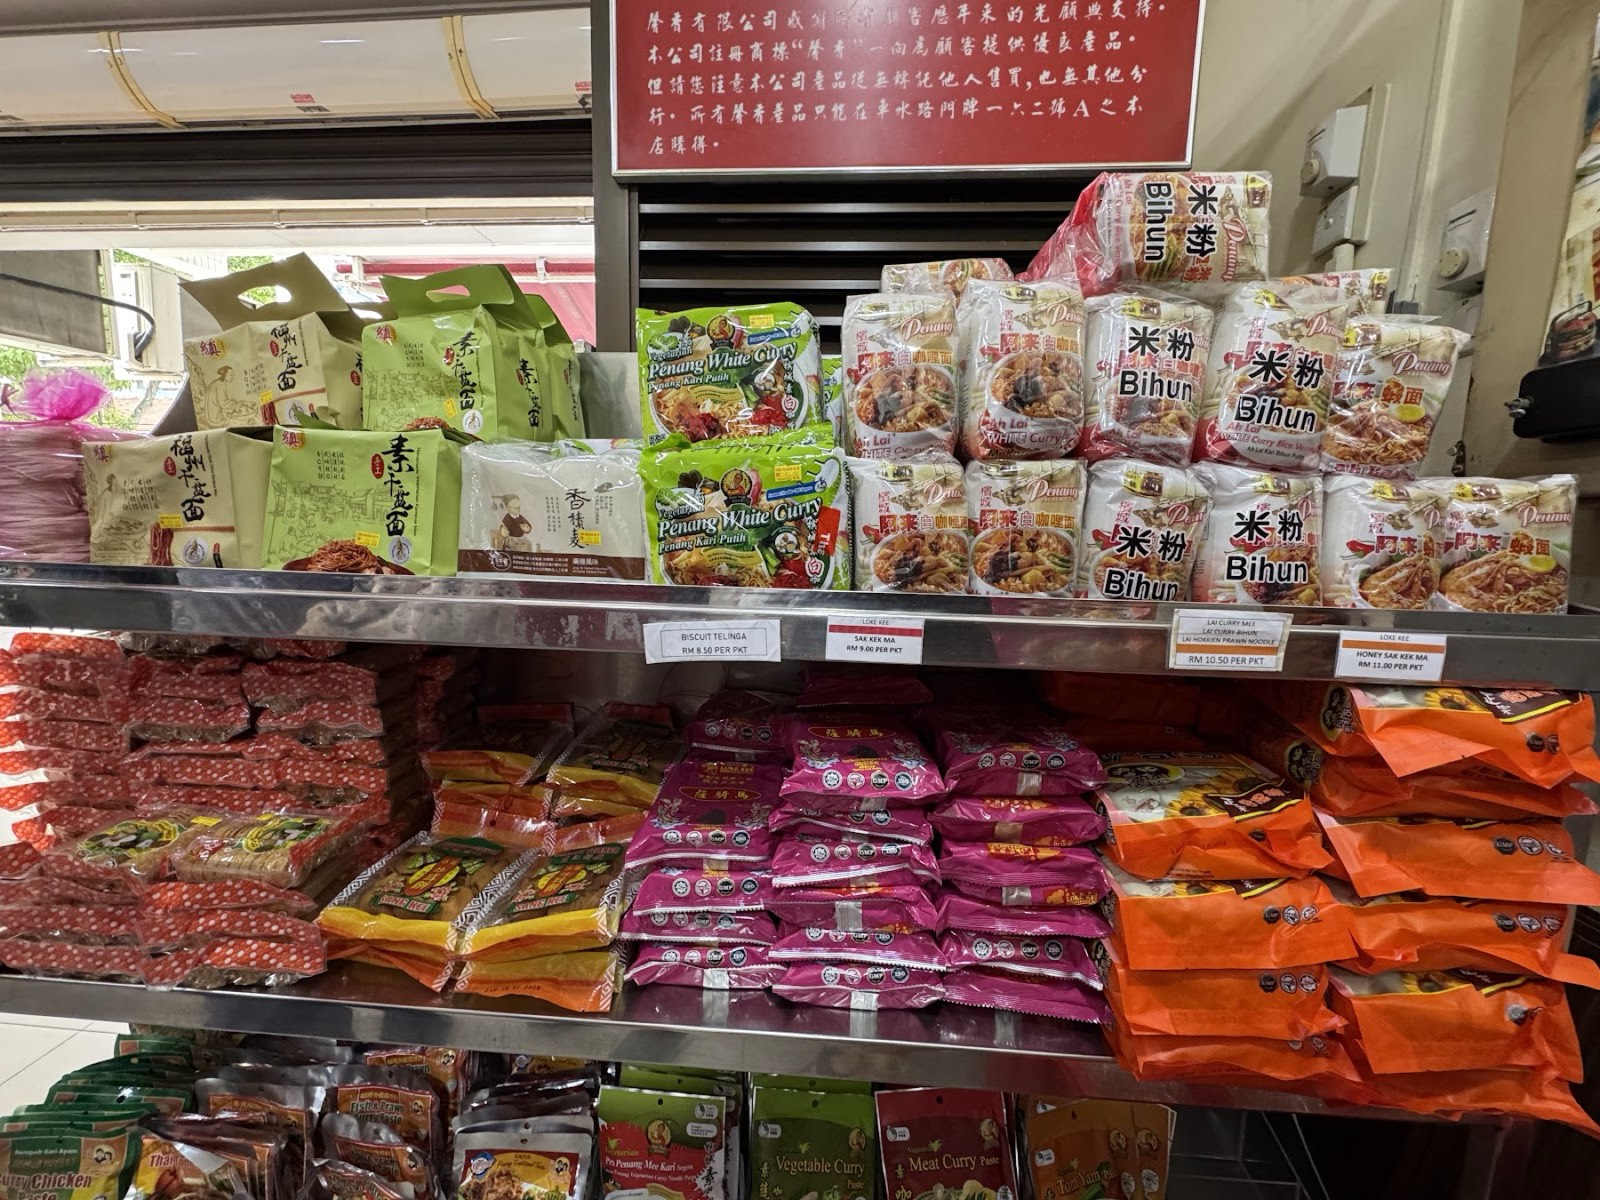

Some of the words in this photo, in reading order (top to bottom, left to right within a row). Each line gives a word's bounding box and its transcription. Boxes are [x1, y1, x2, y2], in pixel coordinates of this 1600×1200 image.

[1145, 182, 1174, 261] Bihun
[1186, 184, 1218, 258] 米粉
[1128, 326, 1195, 362] 米粉
[648, 360, 704, 380] Penang
[707, 351, 750, 371] White
[753, 342, 798, 362] Curry
[1249, 350, 1324, 389] 米粉
[1392, 352, 1450, 377] Penang
[684, 375, 703, 386] Kari
[705, 373, 729, 384] Putih
[1119, 370, 1192, 402] Bihun
[1010, 419, 1028, 429] Lai
[1235, 396, 1317, 433] Bihun
[986, 432, 1027, 444] WHITE
[1029, 433, 1063, 446] Curry
[1027, 478, 1079, 502] Penang
[658, 517, 719, 540] Penang
[721, 509, 770, 530] White
[773, 498, 823, 521] Curry
[1233, 510, 1304, 542] 米粉
[1517, 503, 1573, 529] Penang
[658, 540, 693, 554] Penang
[695, 536, 717, 547] Kari
[719, 533, 747, 545] Putih
[1115, 525, 1186, 563] 米粉
[1226, 556, 1308, 583] Bihun
[1104, 569, 1179, 601] Bihun
[681, 633, 711, 641] BISCUIT
[713, 632, 747, 641] TELINGA
[855, 635, 867, 643] SAK
[1248, 638, 1277, 646] NOODLE
[682, 646, 694, 654] RM
[696, 646, 713, 654] 8.50
[714, 646, 731, 654] PER
[733, 646, 748, 654] PKT
[859, 645, 874, 653] 9.00
[889, 646, 903, 654] PKT
[1189, 655, 1203, 664] RM
[1205, 656, 1229, 664] 10.50
[1230, 656, 1246, 665] PER
[1248, 657, 1264, 665] PKT
[1356, 651, 1382, 659] HONEY
[1384, 652, 1398, 660] SAK
[1358, 661, 1371, 669] RM
[1372, 662, 1394, 670] 11.00
[1395, 663, 1408, 671] PER
[1409, 663, 1424, 671] PKT
[615, 1159, 643, 1170] Penang
[645, 1160, 660, 1170] Mee
[660, 1162, 676, 1171] Kari
[776, 1156, 831, 1176] Vegetable
[834, 1159, 865, 1177] Curry
[909, 1156, 940, 1173] Meat
[942, 1153, 977, 1171] Curry
[980, 1156, 999, 1167] Paste
[0, 1174, 28, 1190] urry
[31, 1171, 93, 1190] Chicken
[847, 1179, 864, 1190] Paste
[1056, 1178, 1078, 1195] Tom
[1079, 1169, 1100, 1187] Yam
